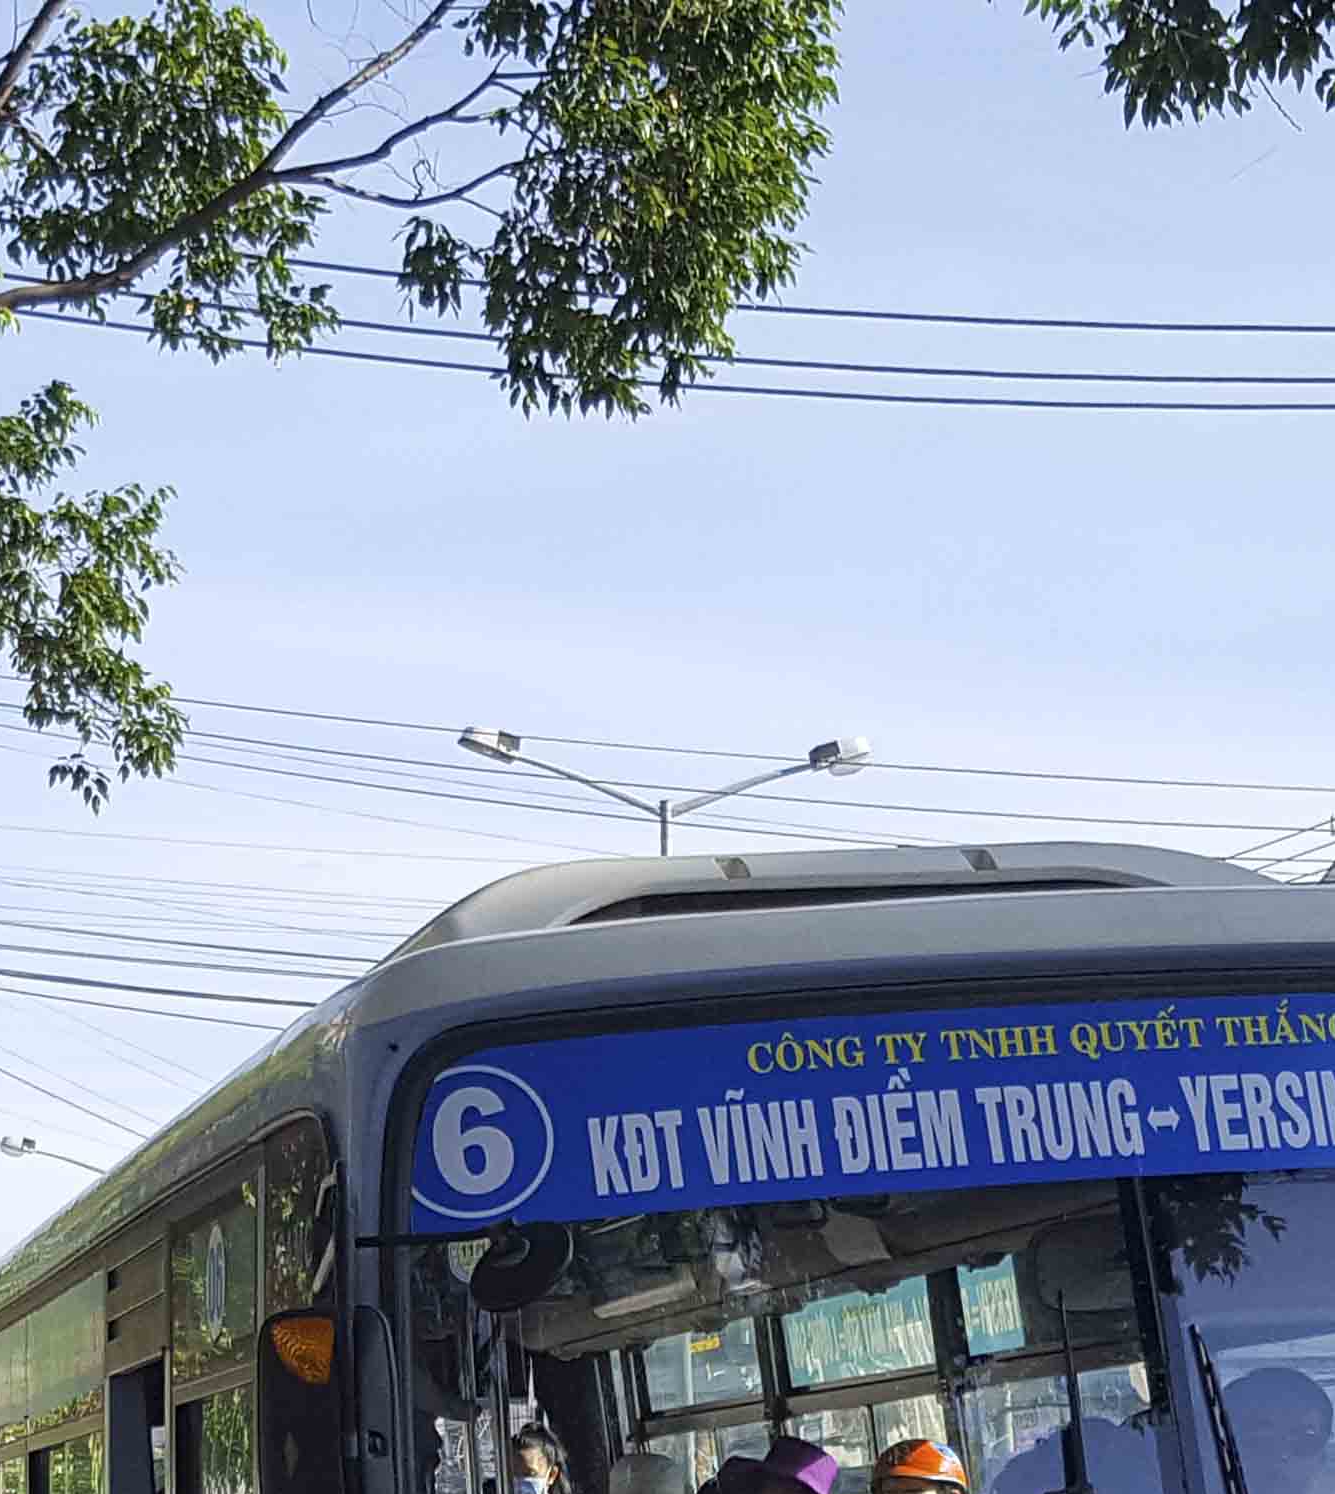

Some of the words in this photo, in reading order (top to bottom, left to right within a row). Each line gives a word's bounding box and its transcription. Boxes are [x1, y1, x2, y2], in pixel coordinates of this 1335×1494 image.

[747, 1031, 865, 1074] CÔNG
[876, 1032, 927, 1065] TY
[940, 1025, 1058, 1060] TNHH
[1069, 1004, 1206, 1060] QUYẾT
[432, 1086, 515, 1195] 6
[587, 1109, 684, 1197] KĐT
[696, 1087, 824, 1185] VĨNH
[832, 1067, 969, 1175] ĐIỀM
[974, 1077, 1146, 1165] TRUNG
